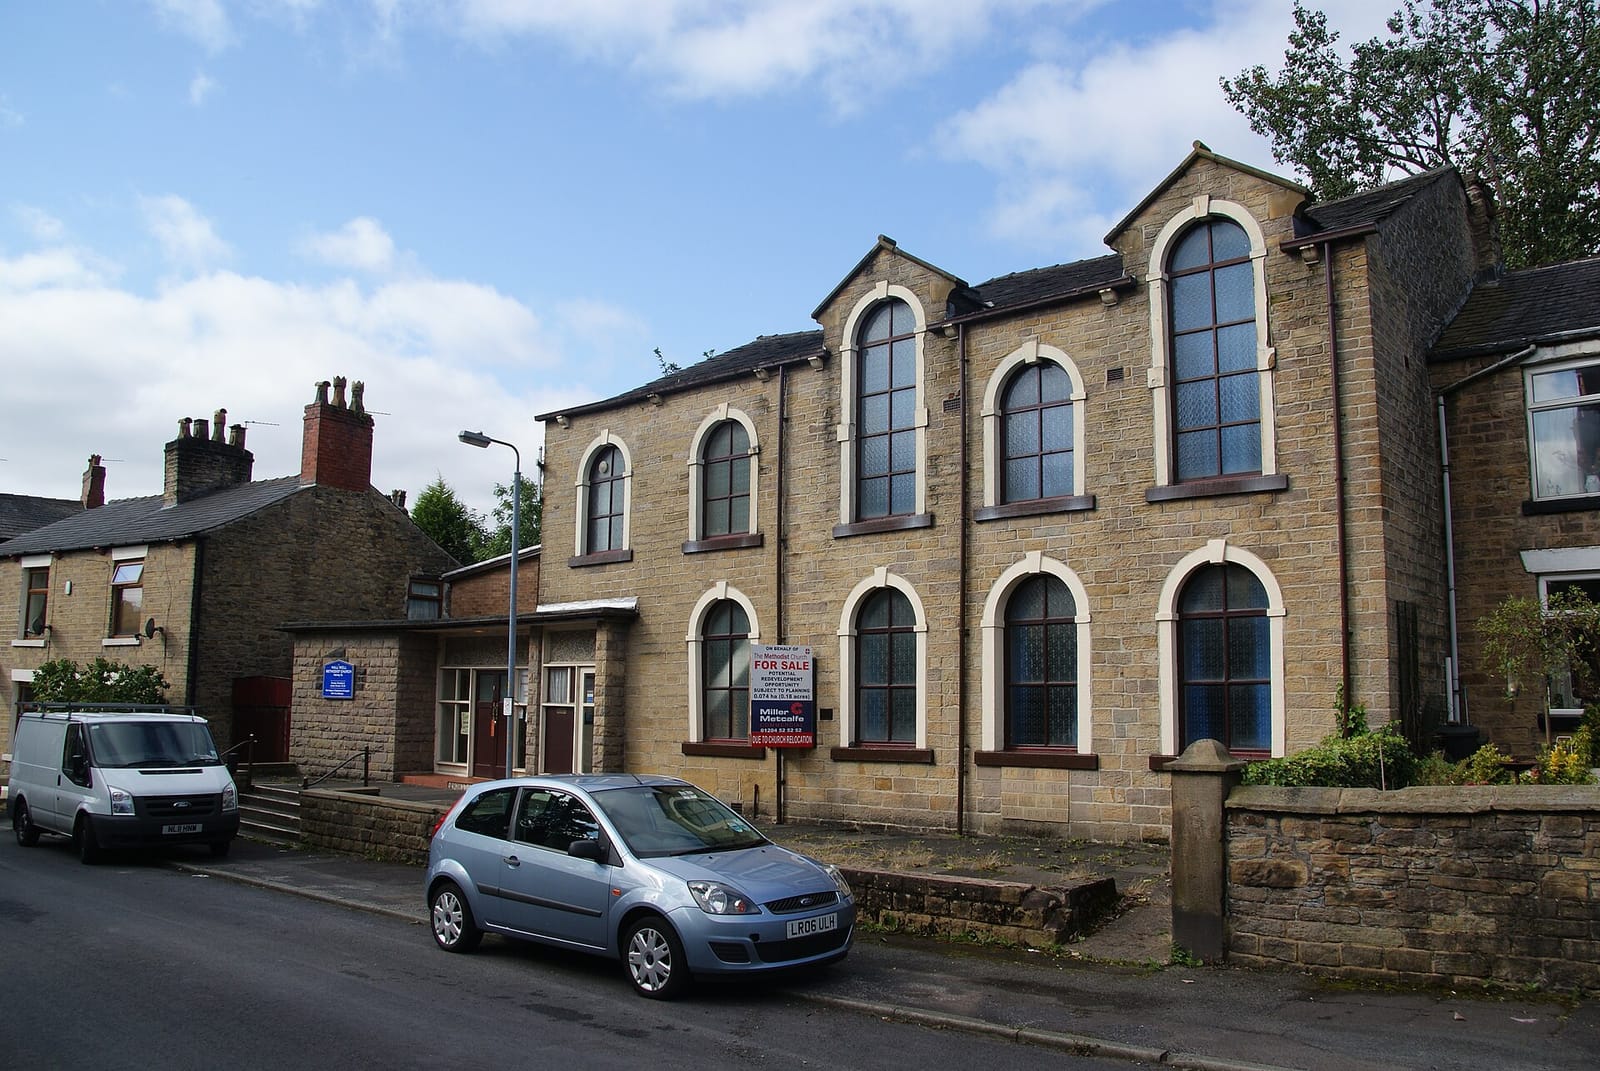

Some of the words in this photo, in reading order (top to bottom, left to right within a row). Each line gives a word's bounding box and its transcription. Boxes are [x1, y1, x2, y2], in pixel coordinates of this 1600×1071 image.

[754, 661, 778, 670] FOR
[781, 661, 809, 670] SALE
[752, 735, 761, 743] DUE
[762, 735, 768, 743] TO
[786, 736, 812, 744] RELOCATION
[791, 920, 816, 936] LR06
[818, 914, 835, 930] ULH
